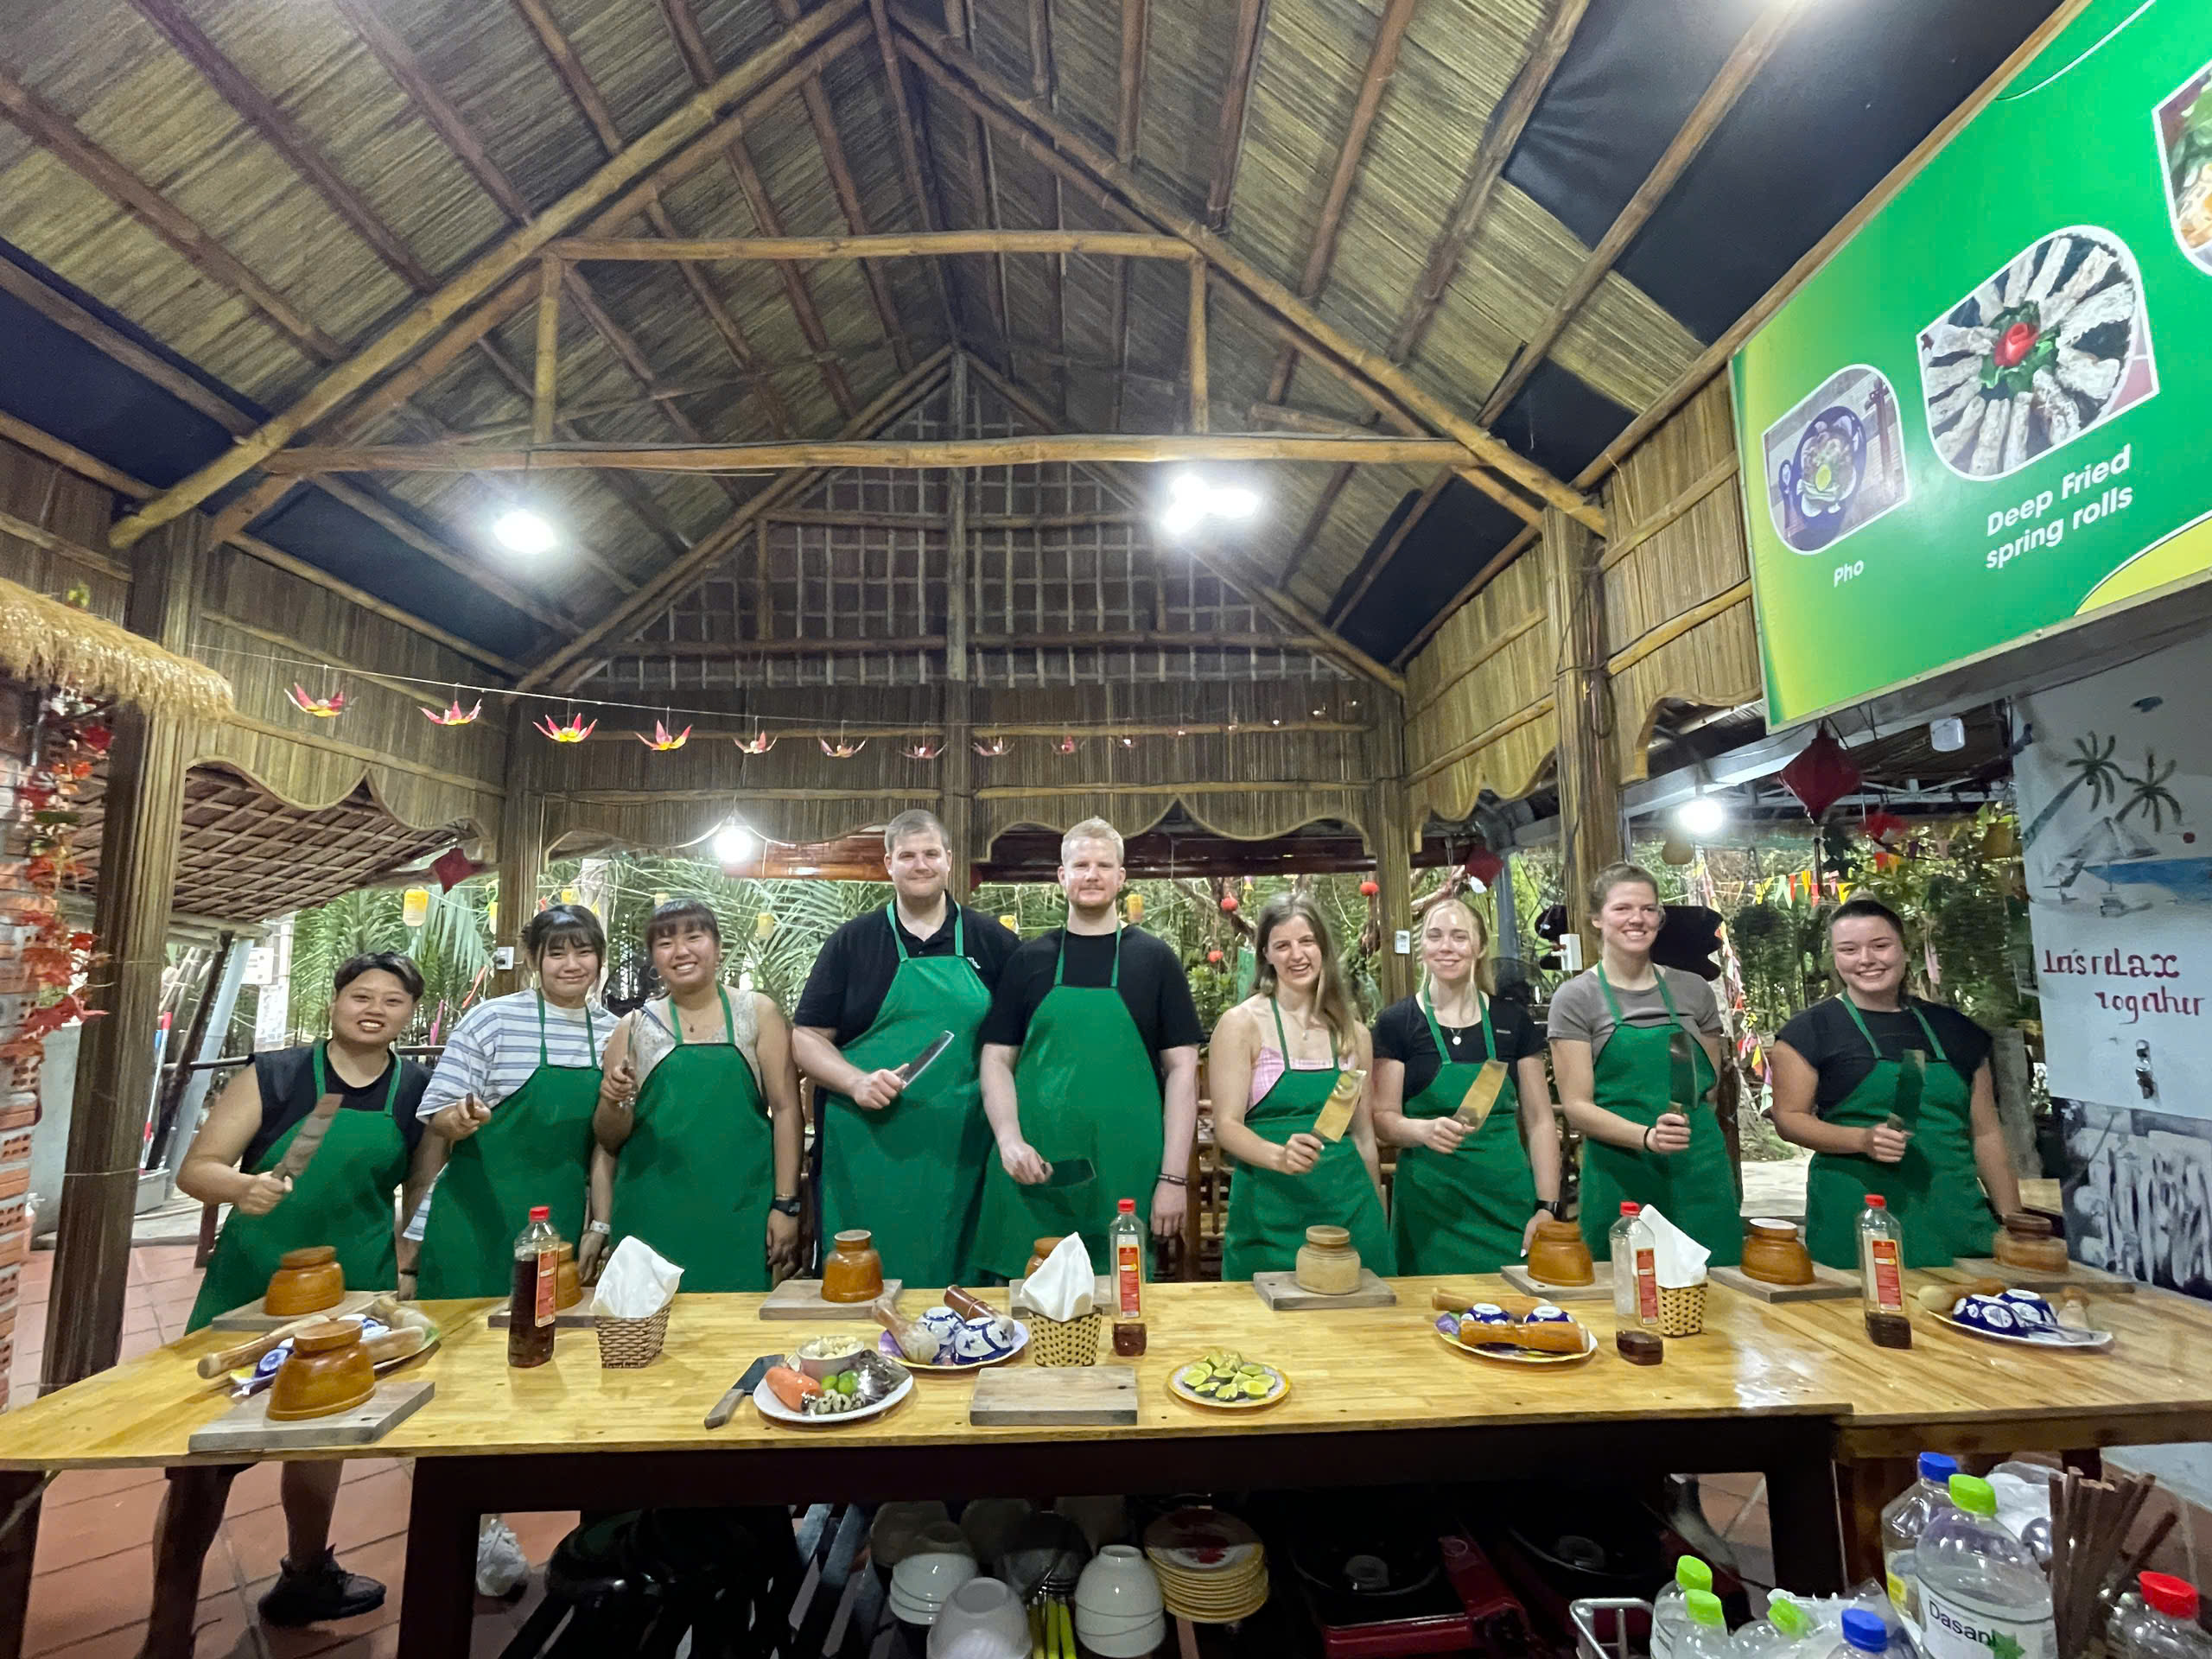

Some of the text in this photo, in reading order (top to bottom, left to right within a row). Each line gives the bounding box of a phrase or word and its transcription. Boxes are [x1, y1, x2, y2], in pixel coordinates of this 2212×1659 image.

[1986, 486, 2133, 569] spring rolls
[1987, 443, 2132, 537] Deep Fried
[1834, 560, 1865, 588] Pho
